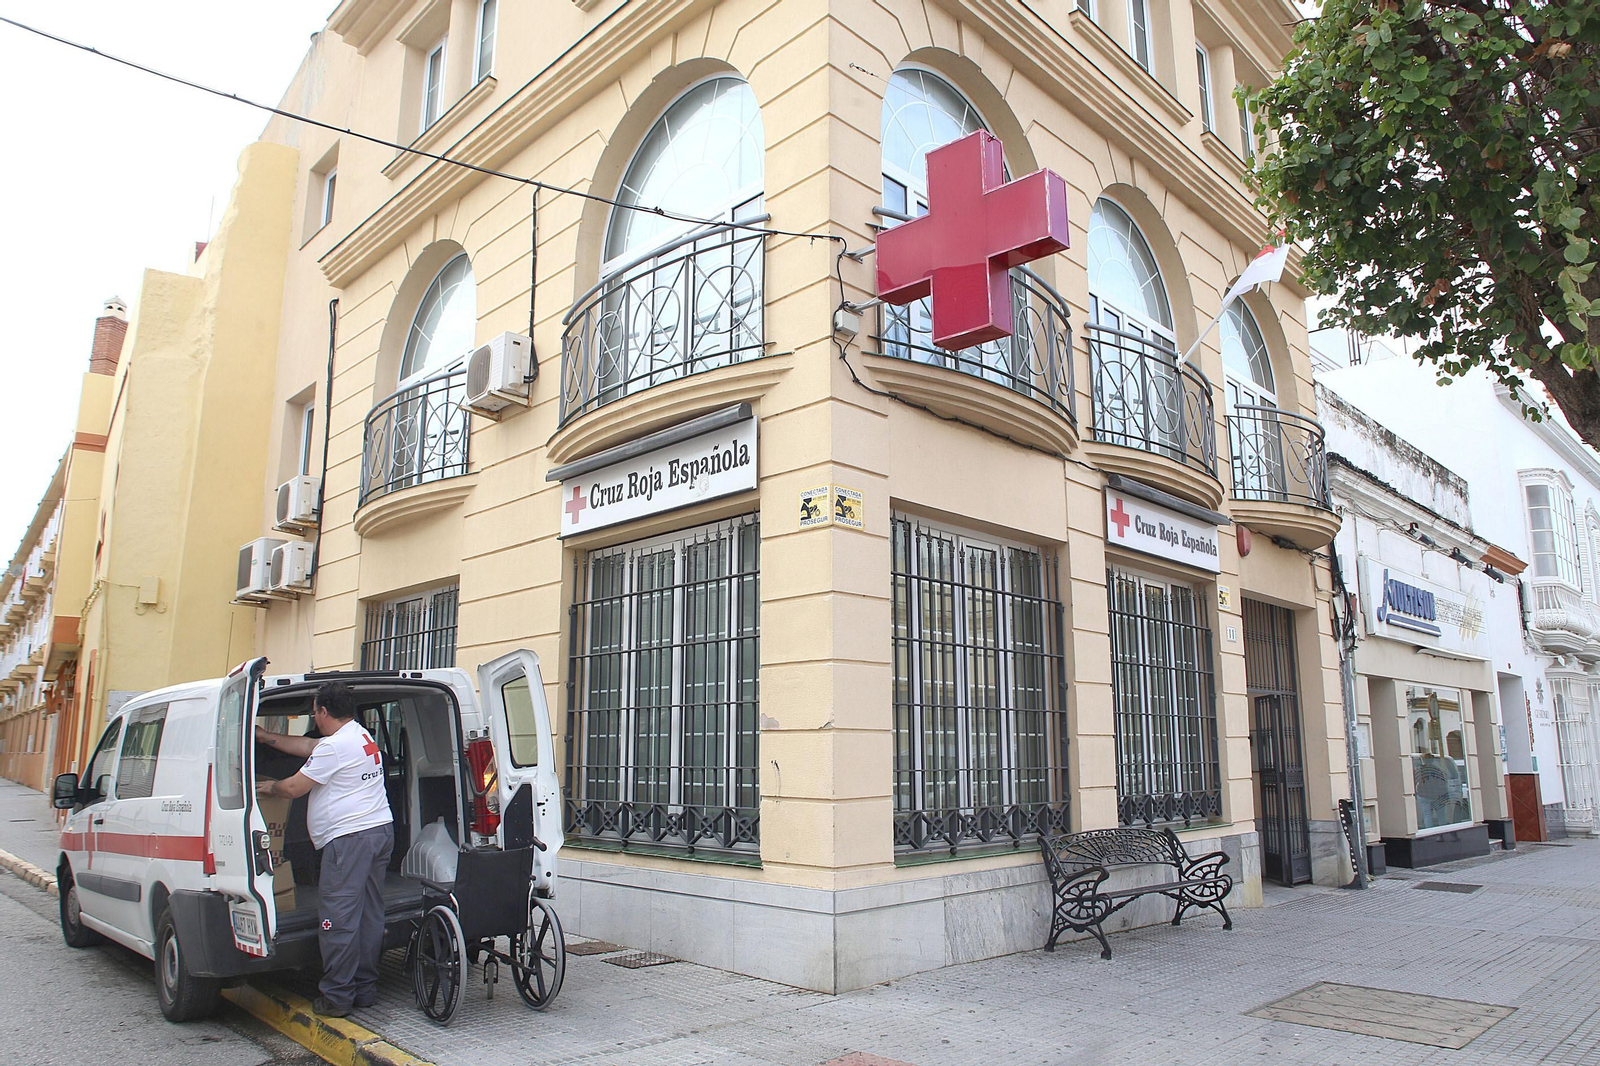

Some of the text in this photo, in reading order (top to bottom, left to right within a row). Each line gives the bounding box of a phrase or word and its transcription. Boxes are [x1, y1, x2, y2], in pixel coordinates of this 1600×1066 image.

[590, 439, 750, 510] Cruz Roja Española
[800, 486, 828, 497] CONECTADA
[834, 486, 861, 498] CONECTADA
[800, 516, 828, 526] PROSEGUR
[835, 516, 862, 527] PROSEGUR
[1135, 514, 1217, 557] Cruz Roja Española
